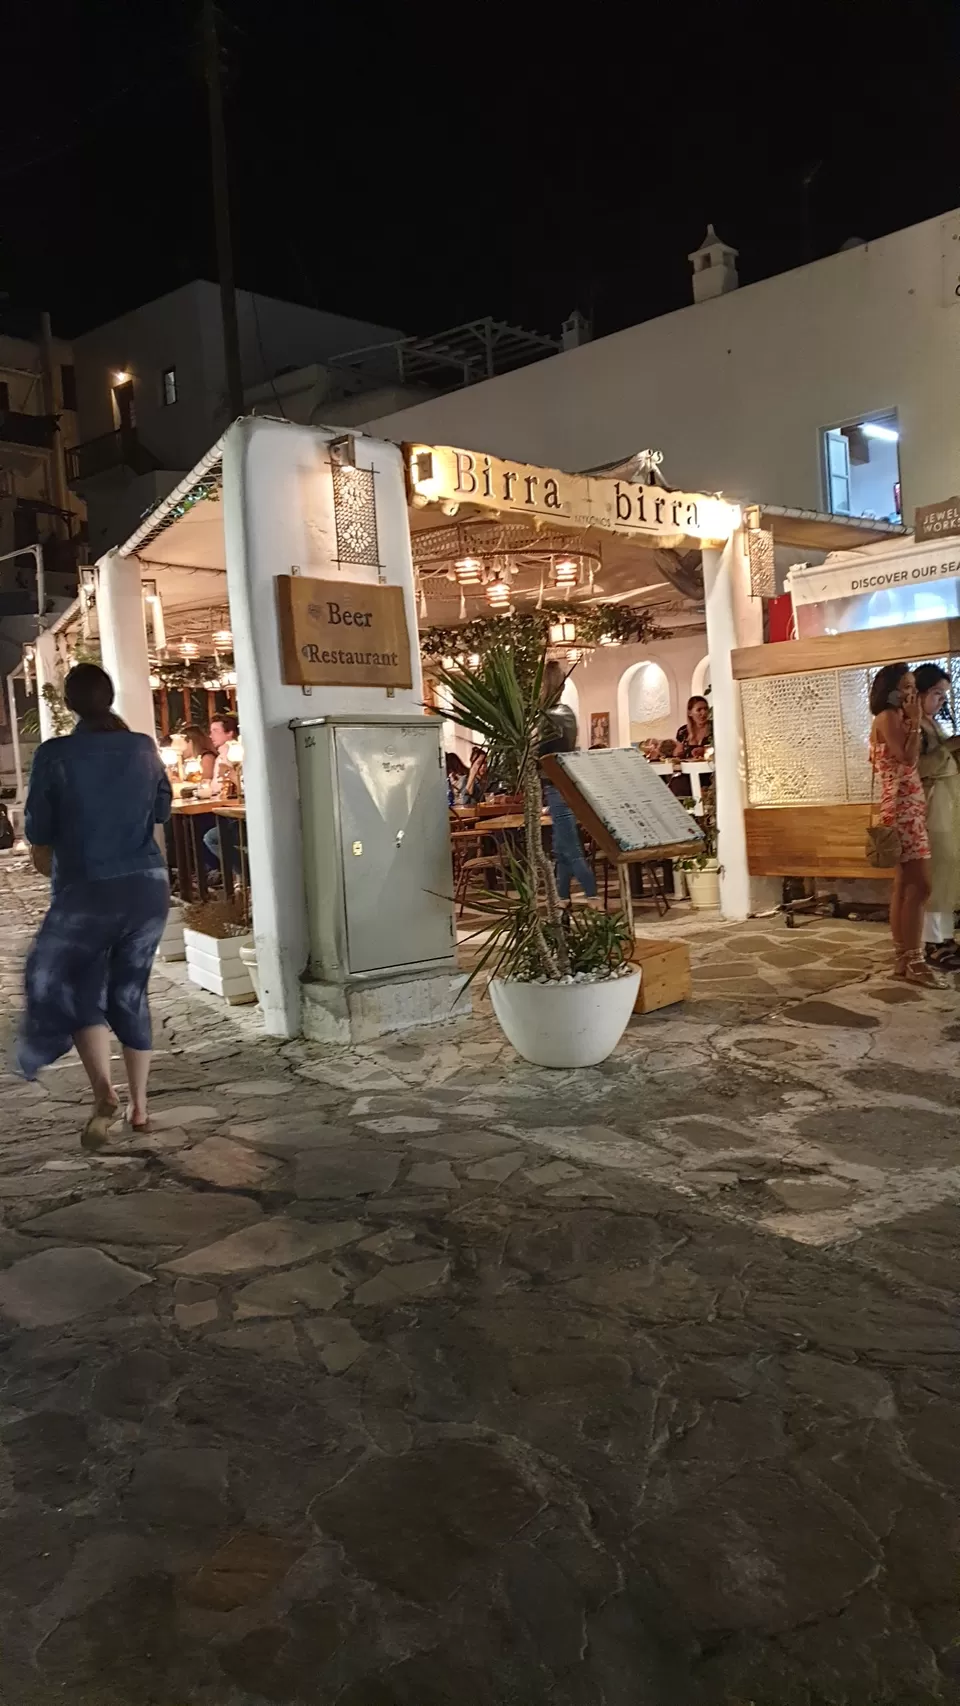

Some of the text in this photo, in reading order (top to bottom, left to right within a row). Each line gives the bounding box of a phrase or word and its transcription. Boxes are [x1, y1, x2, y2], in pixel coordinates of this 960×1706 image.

[452, 450, 700, 528] Birra birra
[923, 508, 959, 525] JEWEL
[851, 571, 908, 590] DISCOVER
[911, 565, 937, 579] OUR
[326, 602, 373, 627] Beer
[307, 644, 399, 667] Restaurant
